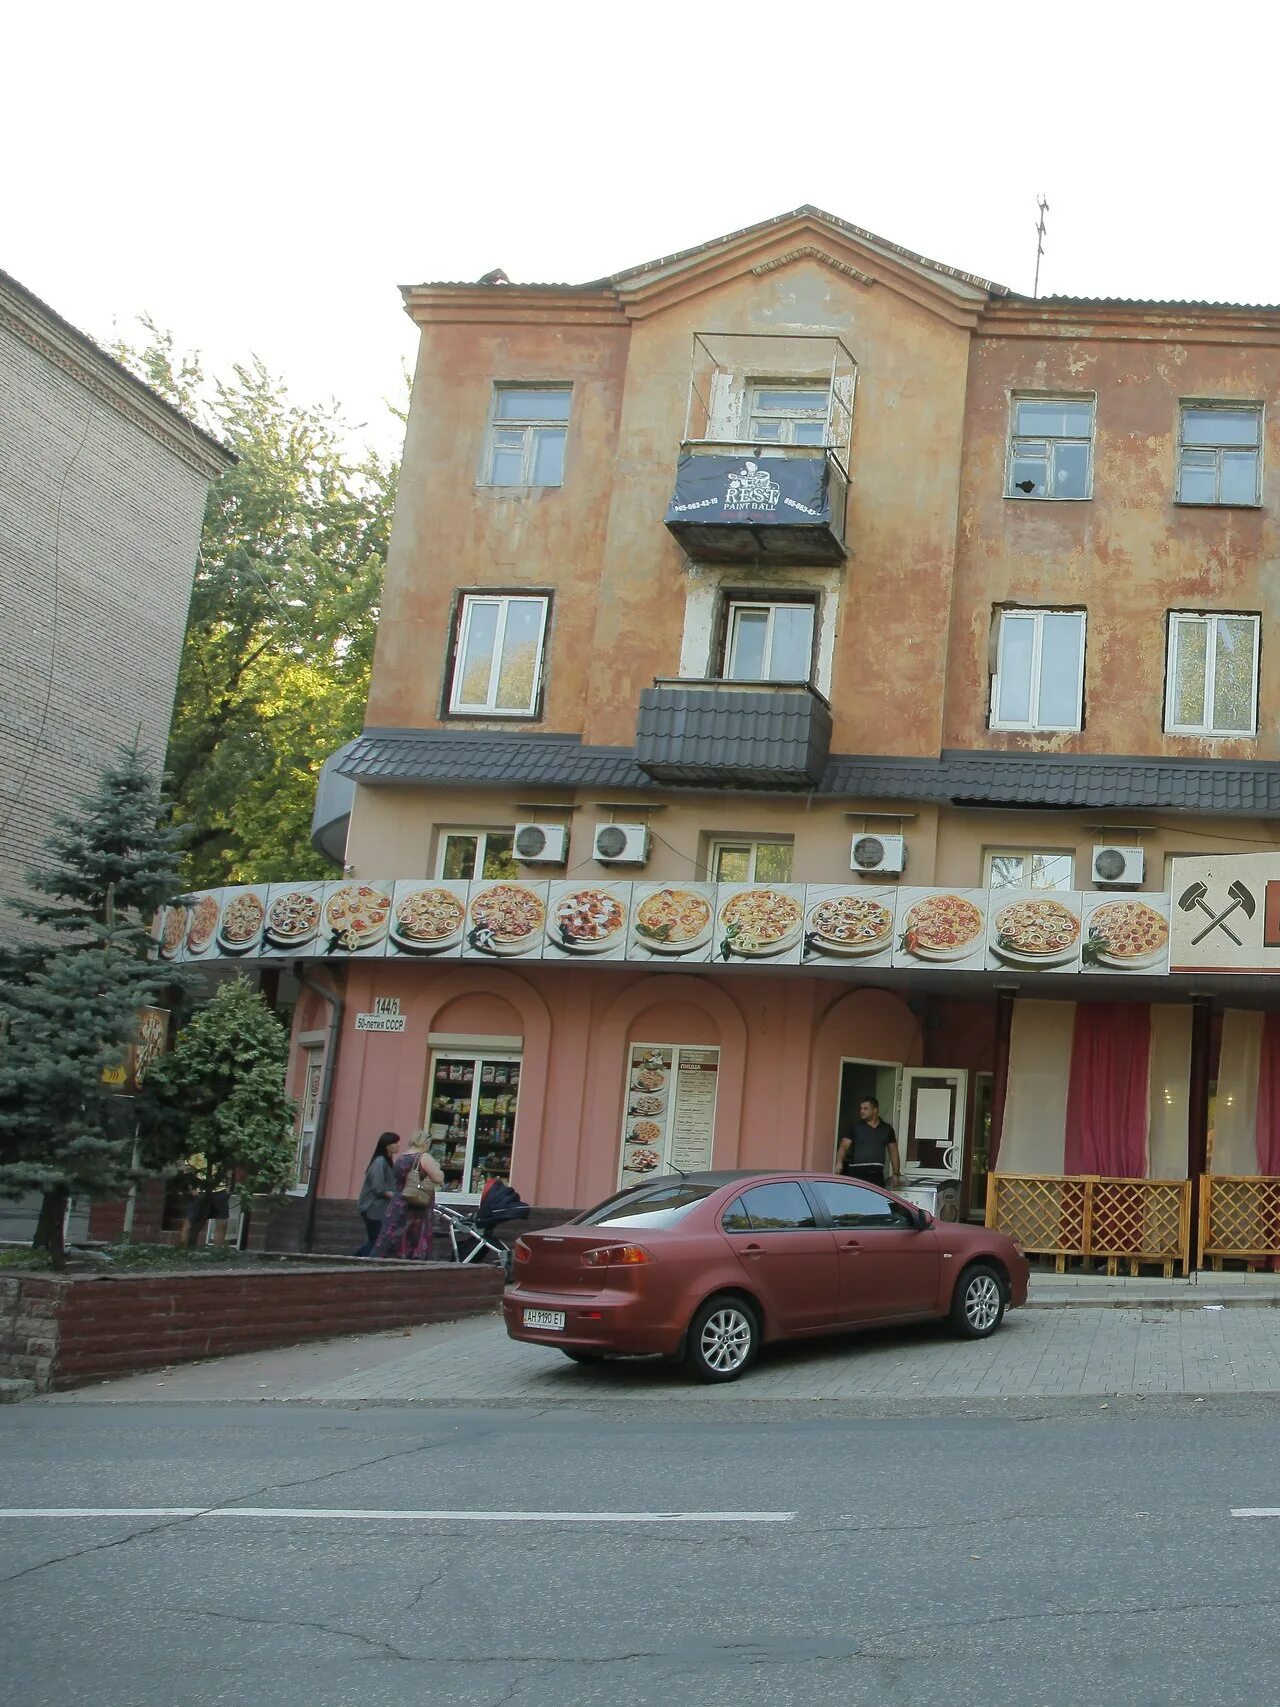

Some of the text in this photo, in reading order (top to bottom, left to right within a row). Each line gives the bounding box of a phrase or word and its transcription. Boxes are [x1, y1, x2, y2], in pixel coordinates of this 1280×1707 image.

[725, 488, 779, 504] REST
[376, 998, 398, 1015] 144/3
[357, 1018, 404, 1030] 50-летия СССР
